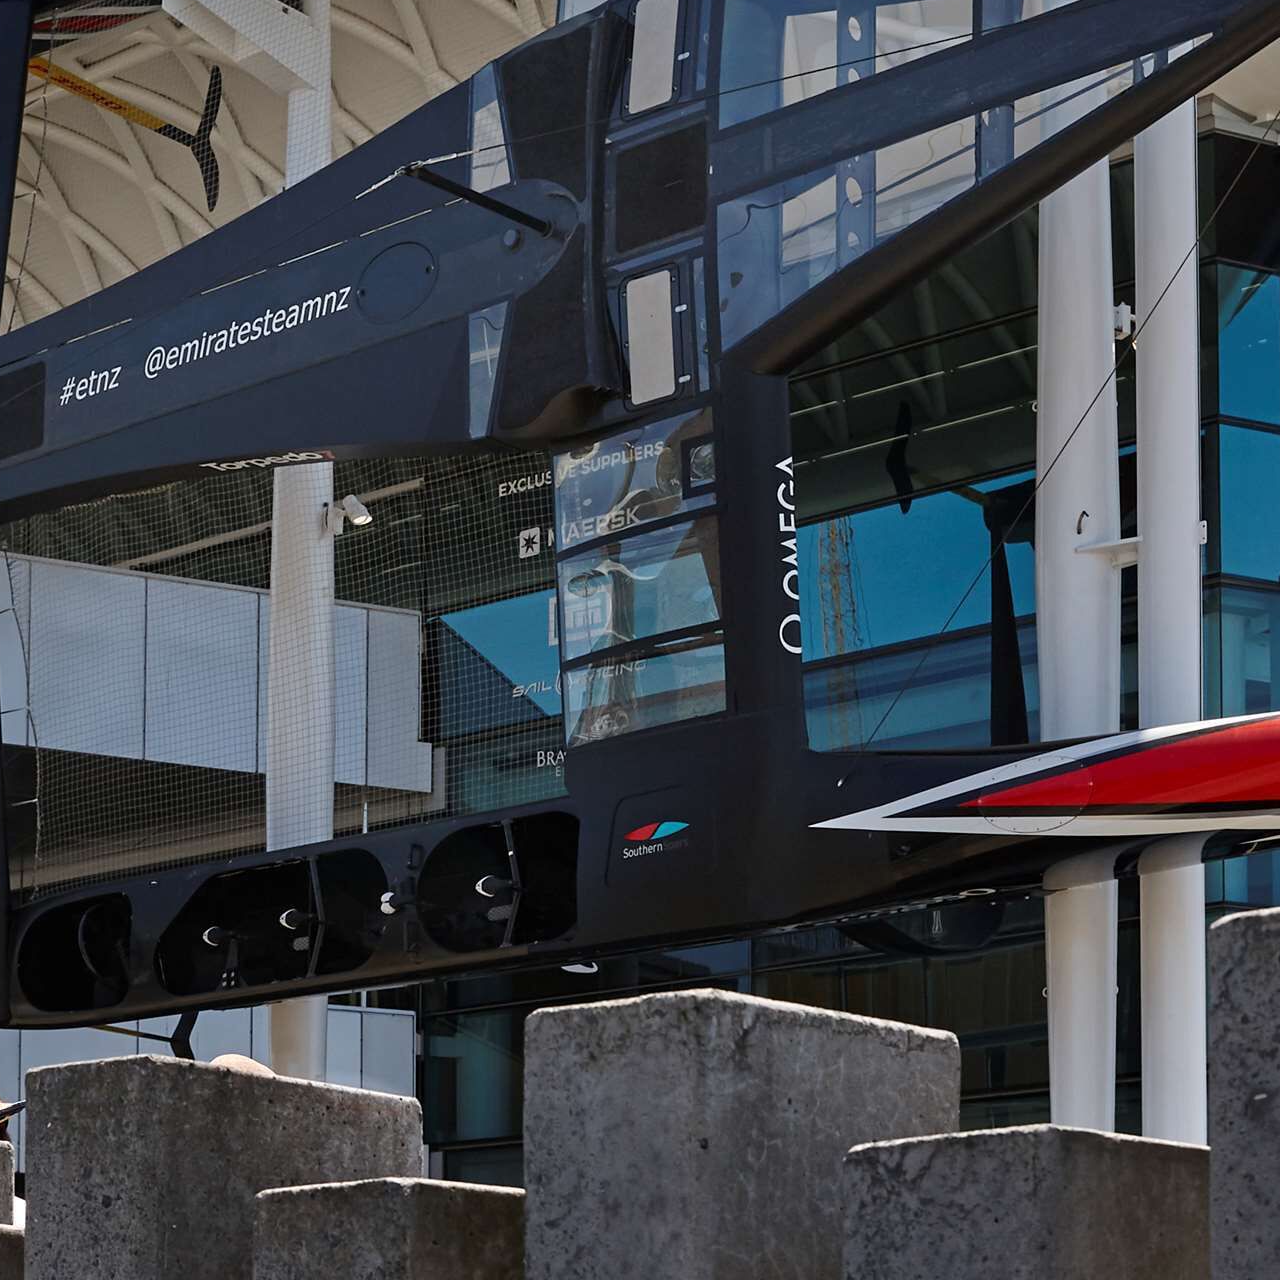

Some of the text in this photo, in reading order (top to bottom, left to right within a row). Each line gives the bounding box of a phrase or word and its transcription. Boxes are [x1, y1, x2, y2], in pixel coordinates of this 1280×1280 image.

[59, 285, 351, 407] #etnz @emiratesteamnz
[581, 440, 664, 476] SUPPLIERS
[512, 680, 553, 698] SAIL
[623, 842, 663, 859] Southern
